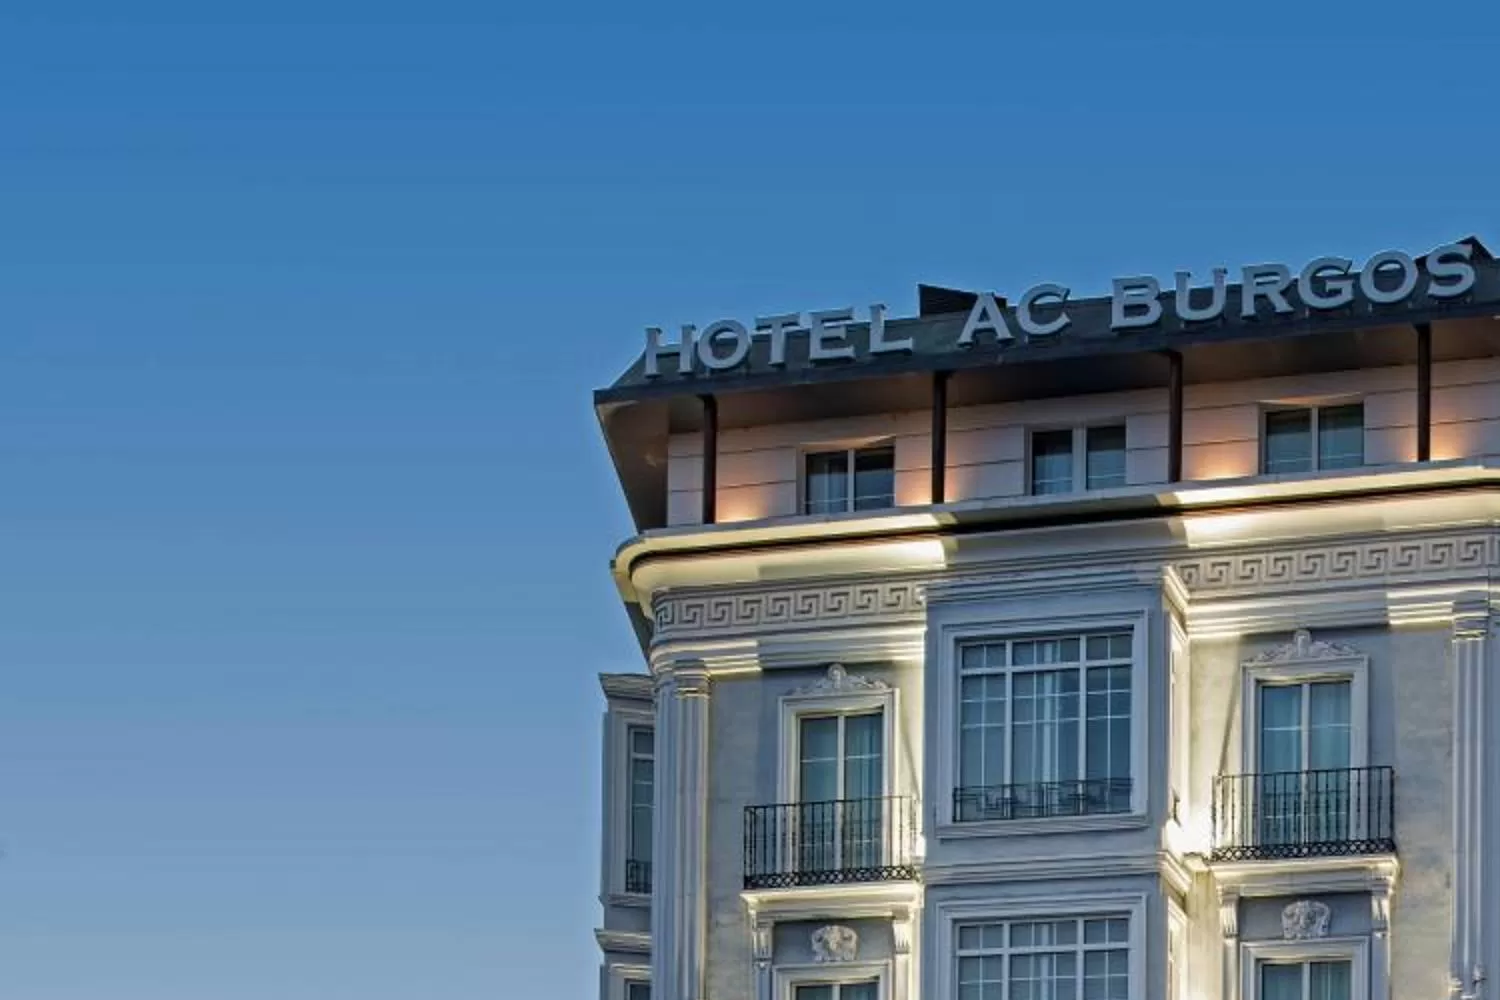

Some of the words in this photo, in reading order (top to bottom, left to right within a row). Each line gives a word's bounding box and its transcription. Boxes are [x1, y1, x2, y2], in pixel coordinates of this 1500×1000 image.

[644, 303, 913, 379] HOTEL
[957, 283, 1072, 349] AC
[1110, 243, 1477, 332] BURGOS
